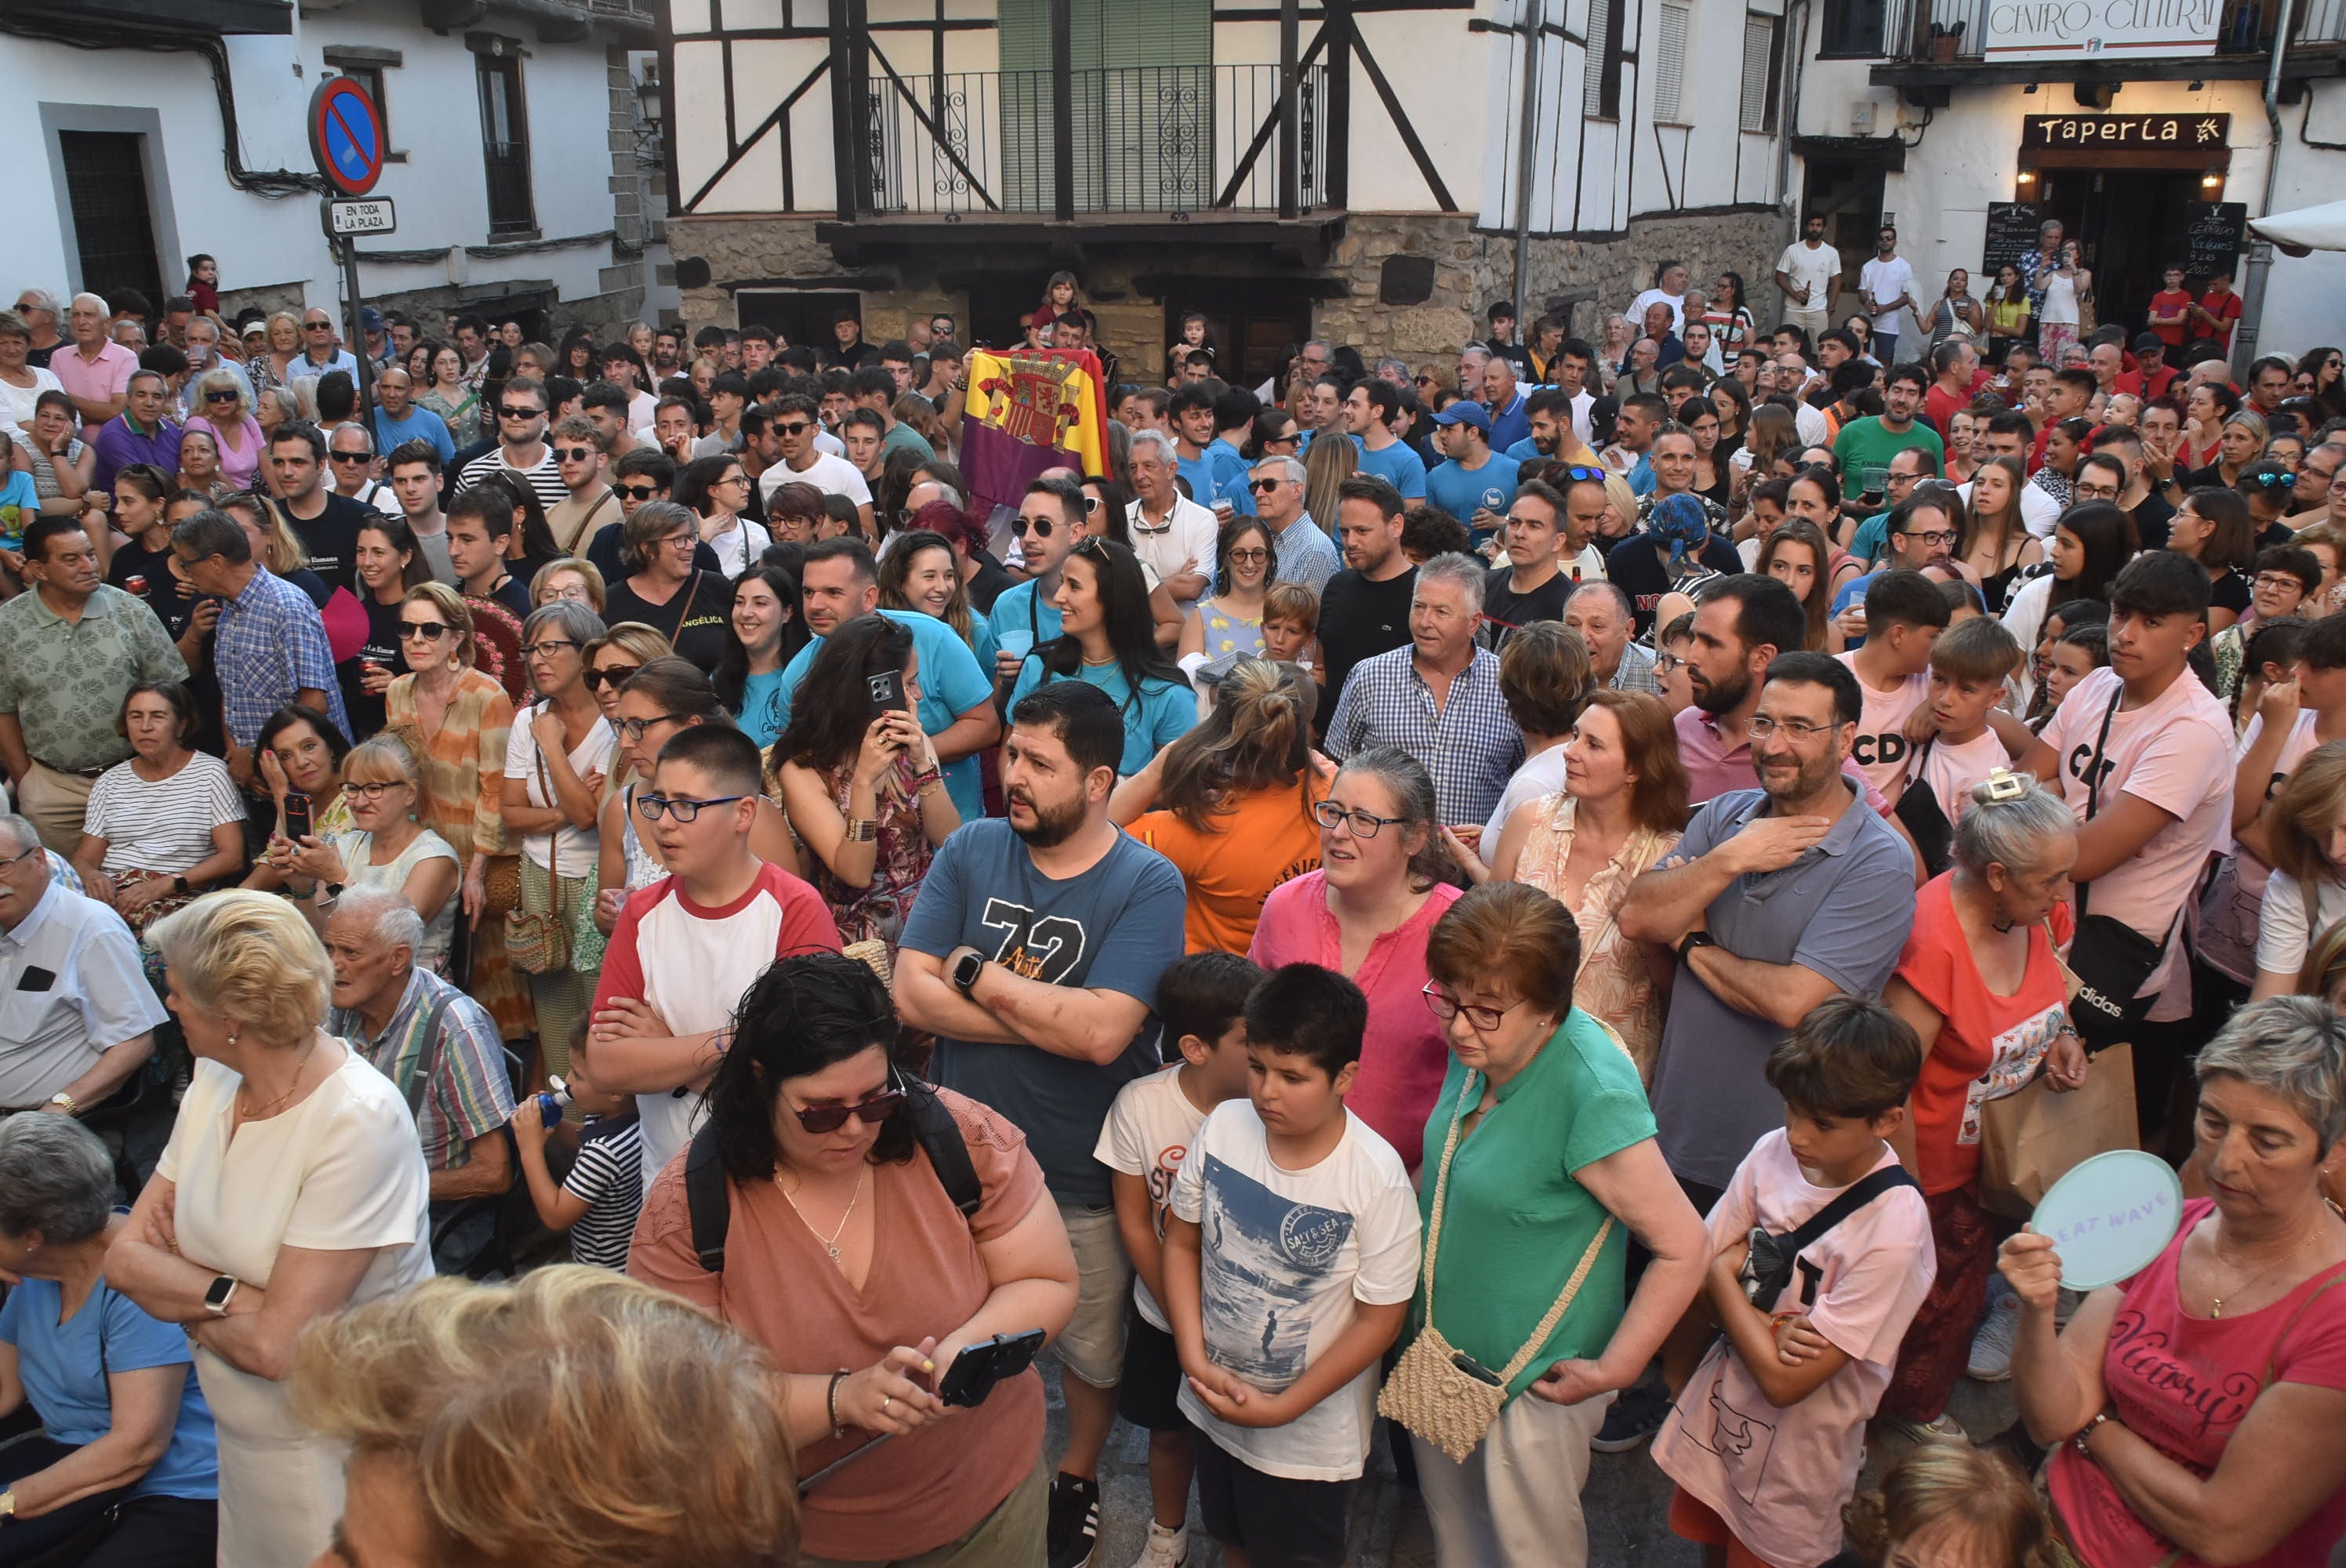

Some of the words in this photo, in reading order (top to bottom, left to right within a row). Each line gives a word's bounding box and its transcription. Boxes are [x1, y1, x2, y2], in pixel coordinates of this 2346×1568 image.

[1991, 2, 2091, 39] CENTRO
[2104, 0, 2217, 34] CULTURAL
[345, 219, 356, 230] LA
[358, 216, 384, 228] PLAZA
[346, 205, 358, 216] EN
[359, 204, 380, 216] TODA
[1635, 593, 1664, 612] NO
[982, 897, 1087, 985] 72
[2079, 986, 2123, 1018] didas
[1287, 1232, 1311, 1249] SALT
[1309, 1227, 1320, 1240] &
[1318, 1218, 1339, 1236] SEA
[2054, 1217, 2100, 1247] EAT
[2108, 1191, 2170, 1229] WAVE
[2110, 1309, 2260, 1438] Victory
